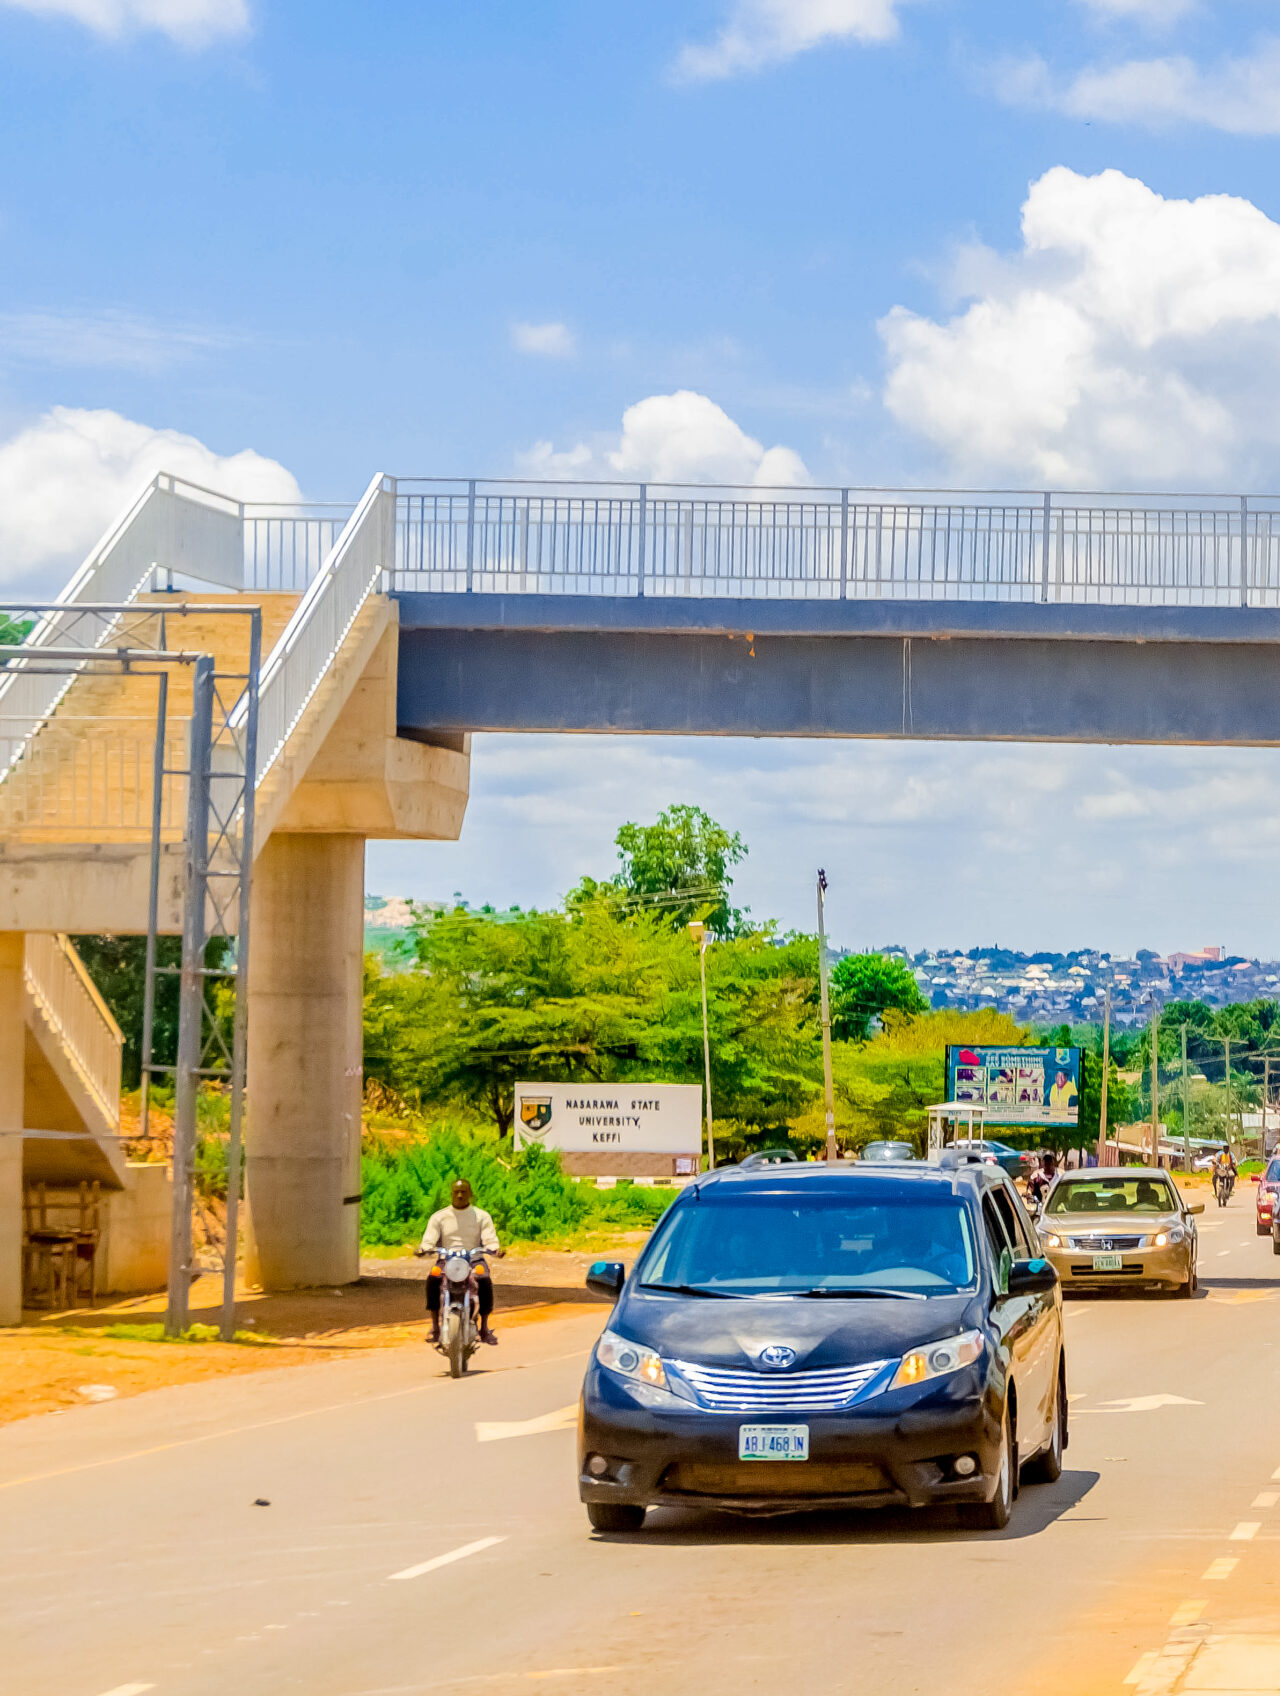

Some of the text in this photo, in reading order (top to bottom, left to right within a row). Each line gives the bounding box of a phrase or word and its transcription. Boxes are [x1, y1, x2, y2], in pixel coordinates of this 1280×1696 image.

[565, 1100, 660, 1111] NASARAWA STATE
[592, 1132, 621, 1143] KEFFI
